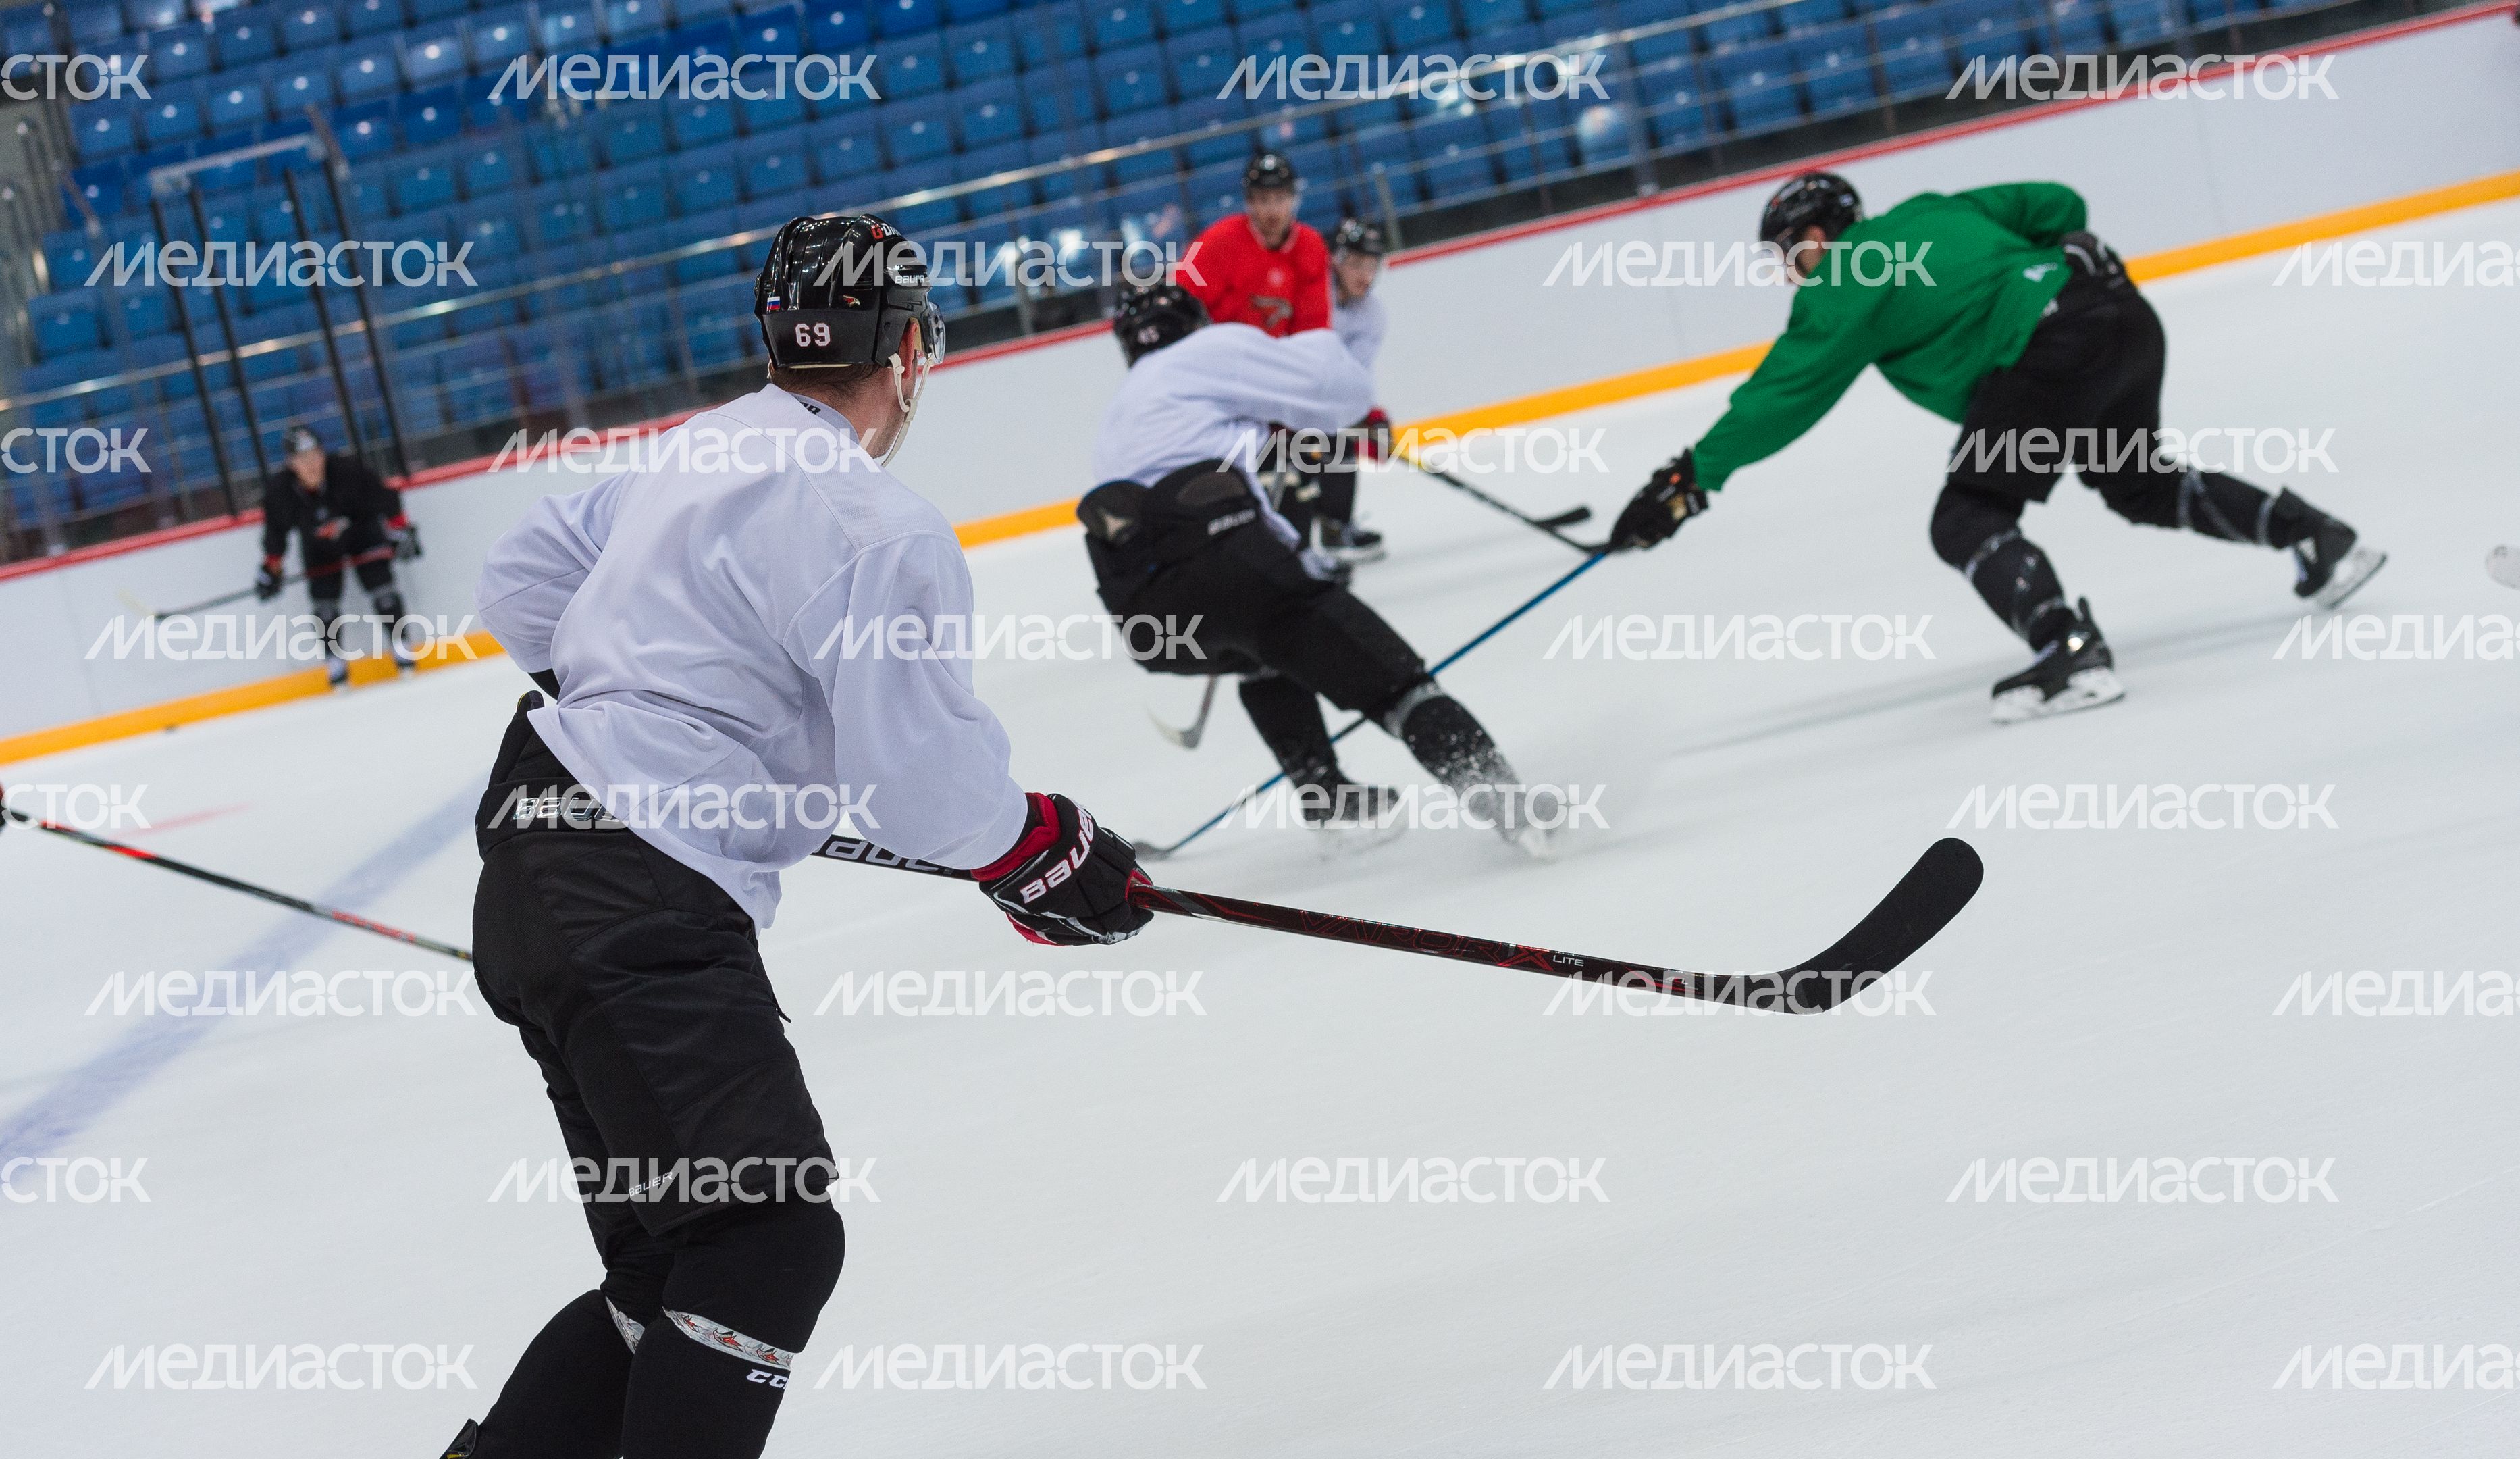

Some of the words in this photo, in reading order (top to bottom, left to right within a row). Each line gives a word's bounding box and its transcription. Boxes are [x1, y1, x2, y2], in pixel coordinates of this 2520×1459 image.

[795, 322, 831, 347] 69
[1553, 954, 1585, 967] LITE
[745, 1368, 790, 1389] CC
